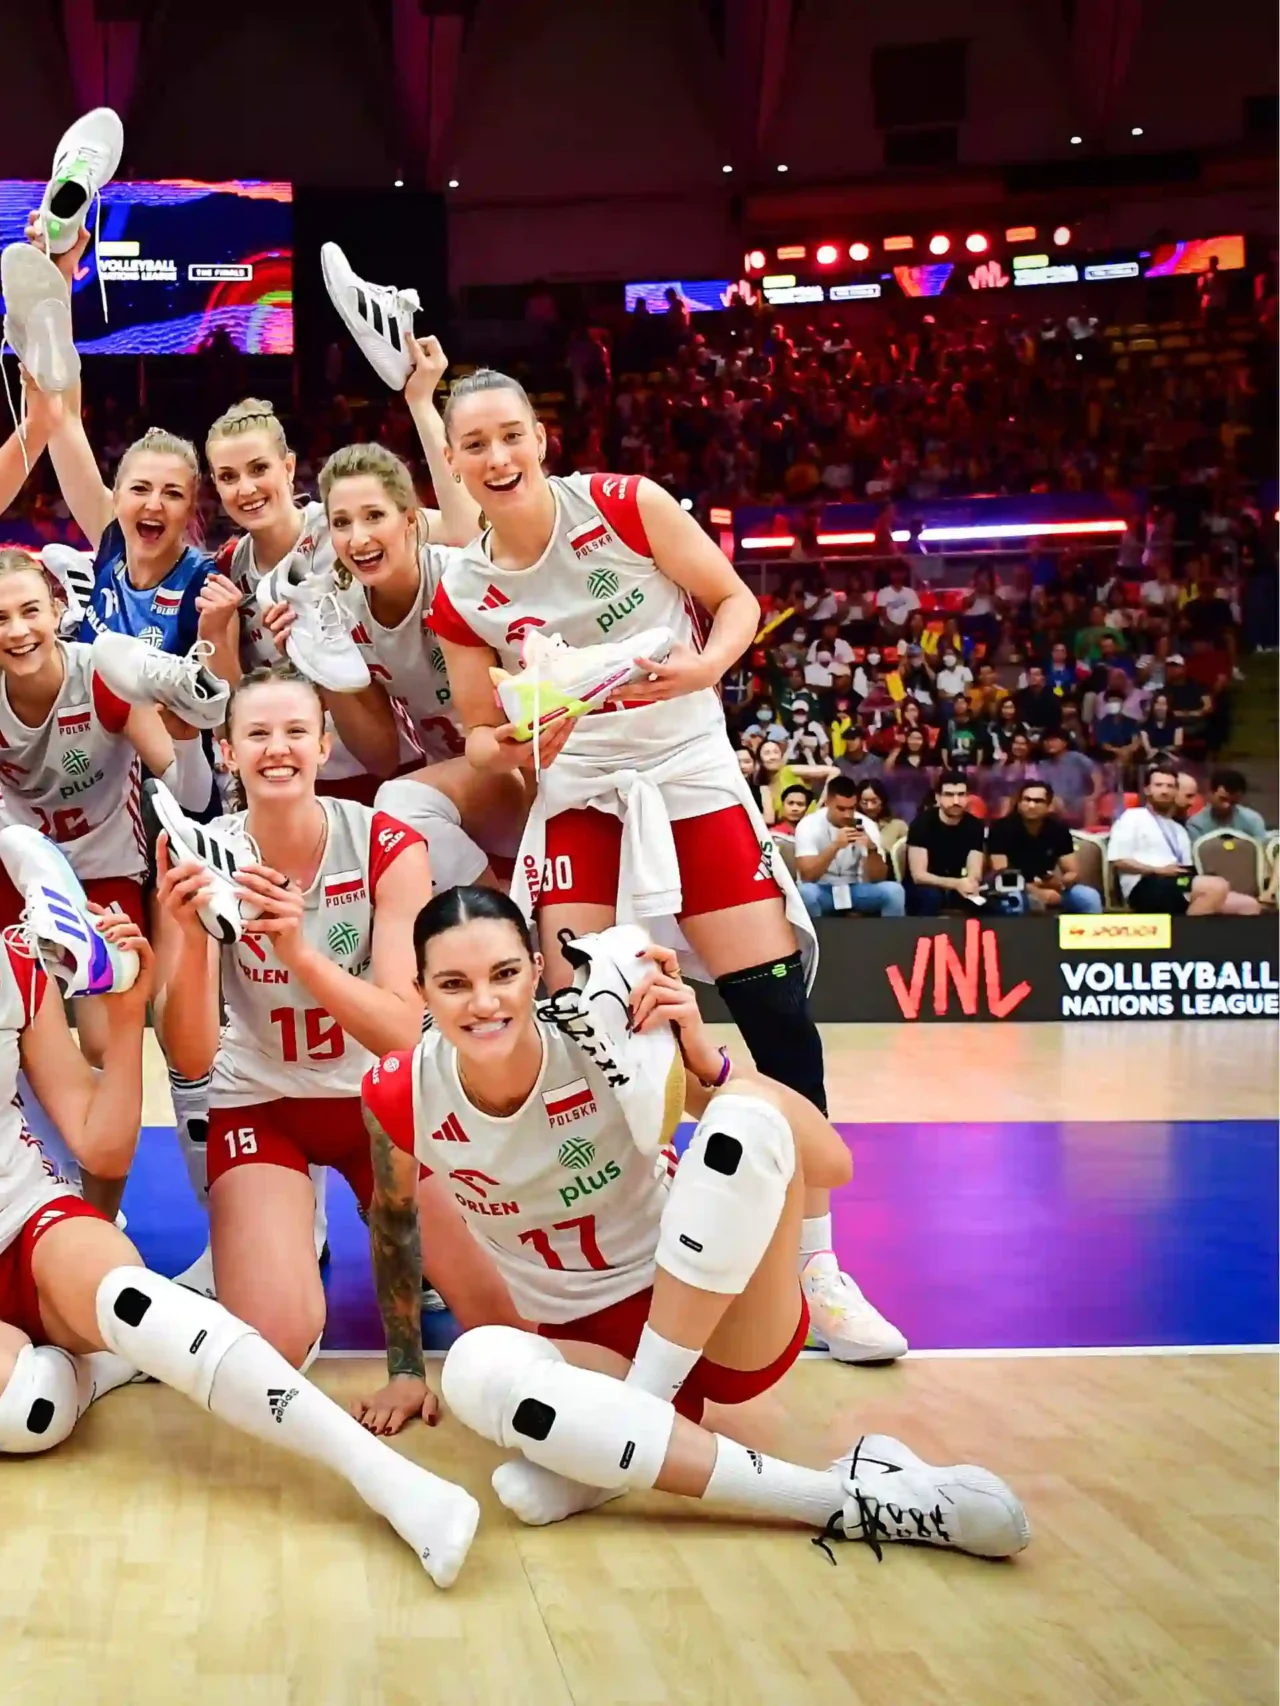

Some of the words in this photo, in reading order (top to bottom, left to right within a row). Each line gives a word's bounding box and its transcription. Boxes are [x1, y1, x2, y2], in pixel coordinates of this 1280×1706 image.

[575, 534, 613, 560] POLSKA
[595, 587, 645, 633] plus
[60, 722, 92, 736] POLSK
[60, 769, 105, 799] plus
[325, 889, 367, 909] POLSKA
[885, 919, 1032, 1019] VNL
[1060, 961, 1279, 991] VOLLEYBALL
[1062, 994, 1175, 1016] NATIONS
[1182, 993, 1279, 1015] LEAGUE
[270, 1006, 345, 1062] 15
[548, 1102, 598, 1129] POLSKA
[224, 1127, 259, 1159] 15
[558, 1159, 622, 1208] plus
[455, 1192, 520, 1216] ORLEN
[517, 1214, 610, 1272] 17
